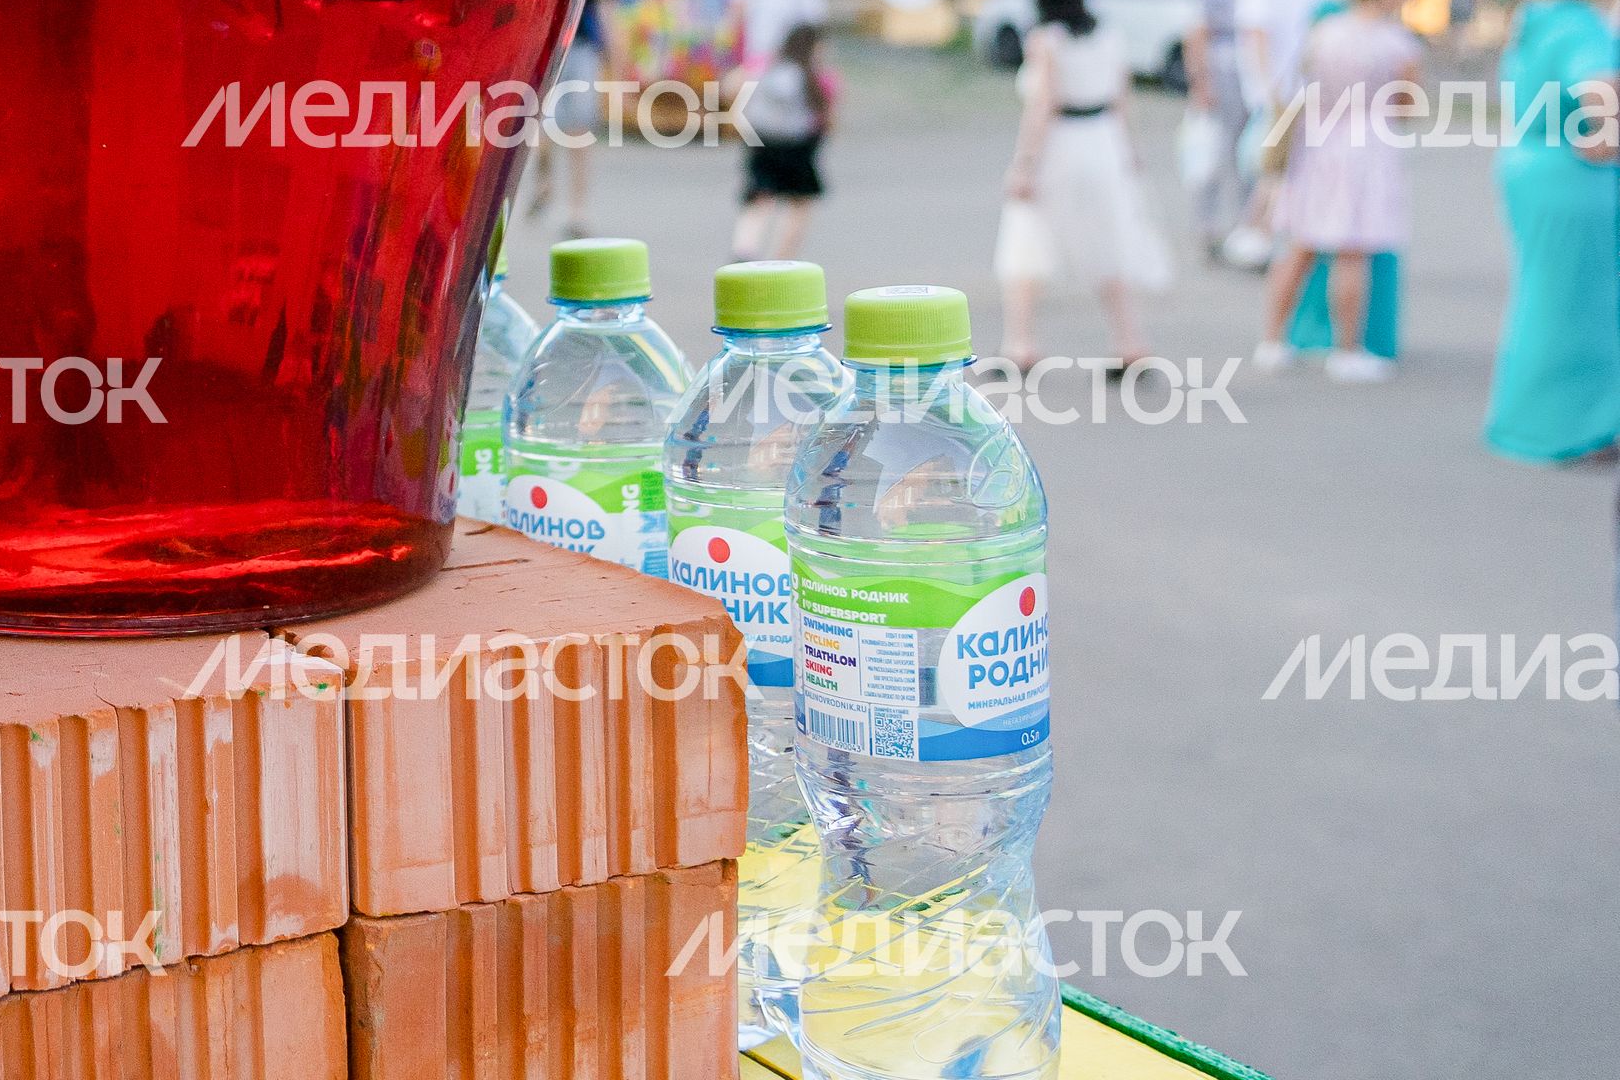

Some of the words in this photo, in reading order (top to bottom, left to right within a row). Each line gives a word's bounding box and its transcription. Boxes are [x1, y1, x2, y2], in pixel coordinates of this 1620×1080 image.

[851, 590, 909, 604] РОДНИК
[803, 616, 853, 638] SWIMMING
[804, 631, 840, 650] CYCLING
[804, 644, 857, 667] TRIATHLON
[805, 659, 833, 676] SKIING
[805, 671, 838, 691] HEALTH
[967, 691, 1026, 710] МИНЕРАЛЬНАЯ
